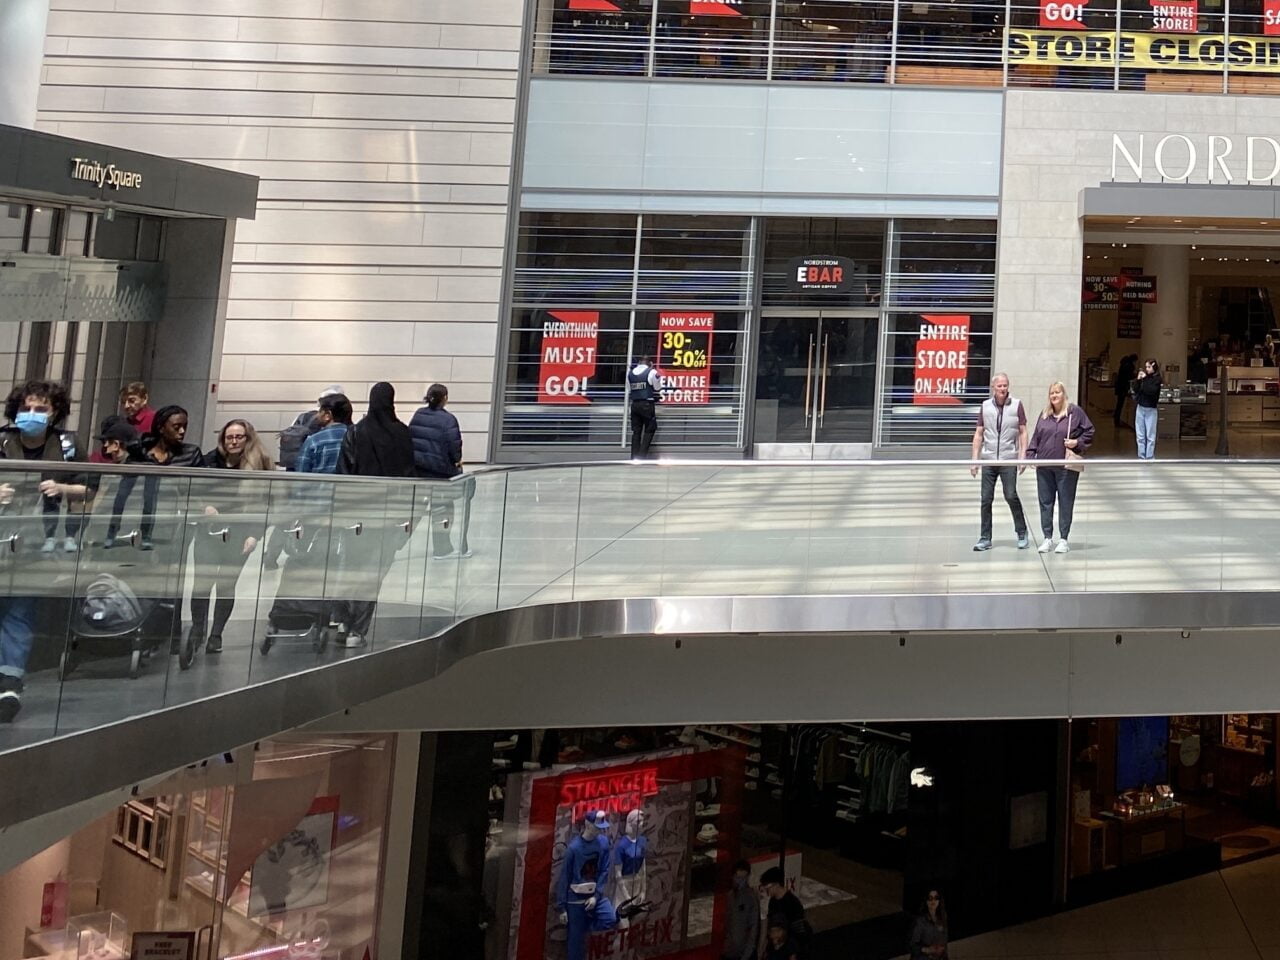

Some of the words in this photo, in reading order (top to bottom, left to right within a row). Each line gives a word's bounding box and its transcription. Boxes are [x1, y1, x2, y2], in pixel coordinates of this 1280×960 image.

[1045, 3, 1083, 22] GO!
[1153, 5, 1194, 18] ENTIRE
[1153, 18, 1193, 31] STORE!
[1009, 33, 1135, 62] STORE
[73, 158, 107, 188] Trinity
[107, 164, 142, 190] Square
[797, 266, 843, 282] EBAR
[543, 321, 598, 338] EVERYTHING
[661, 316, 685, 326] NOW
[688, 316, 713, 327] SAVE
[919, 324, 967, 340] ENTIRE
[663, 332, 692, 349] 30-
[544, 347, 595, 363] MUST
[672, 350, 706, 368] 50%
[917, 350, 966, 369] STORE
[545, 376, 588, 396] GO!
[660, 375, 706, 388] ENTIRE
[915, 378, 932, 393] ON
[936, 378, 966, 394] SALE!
[659, 389, 705, 402] STORE!
[560, 769, 659, 807] STRANGER
